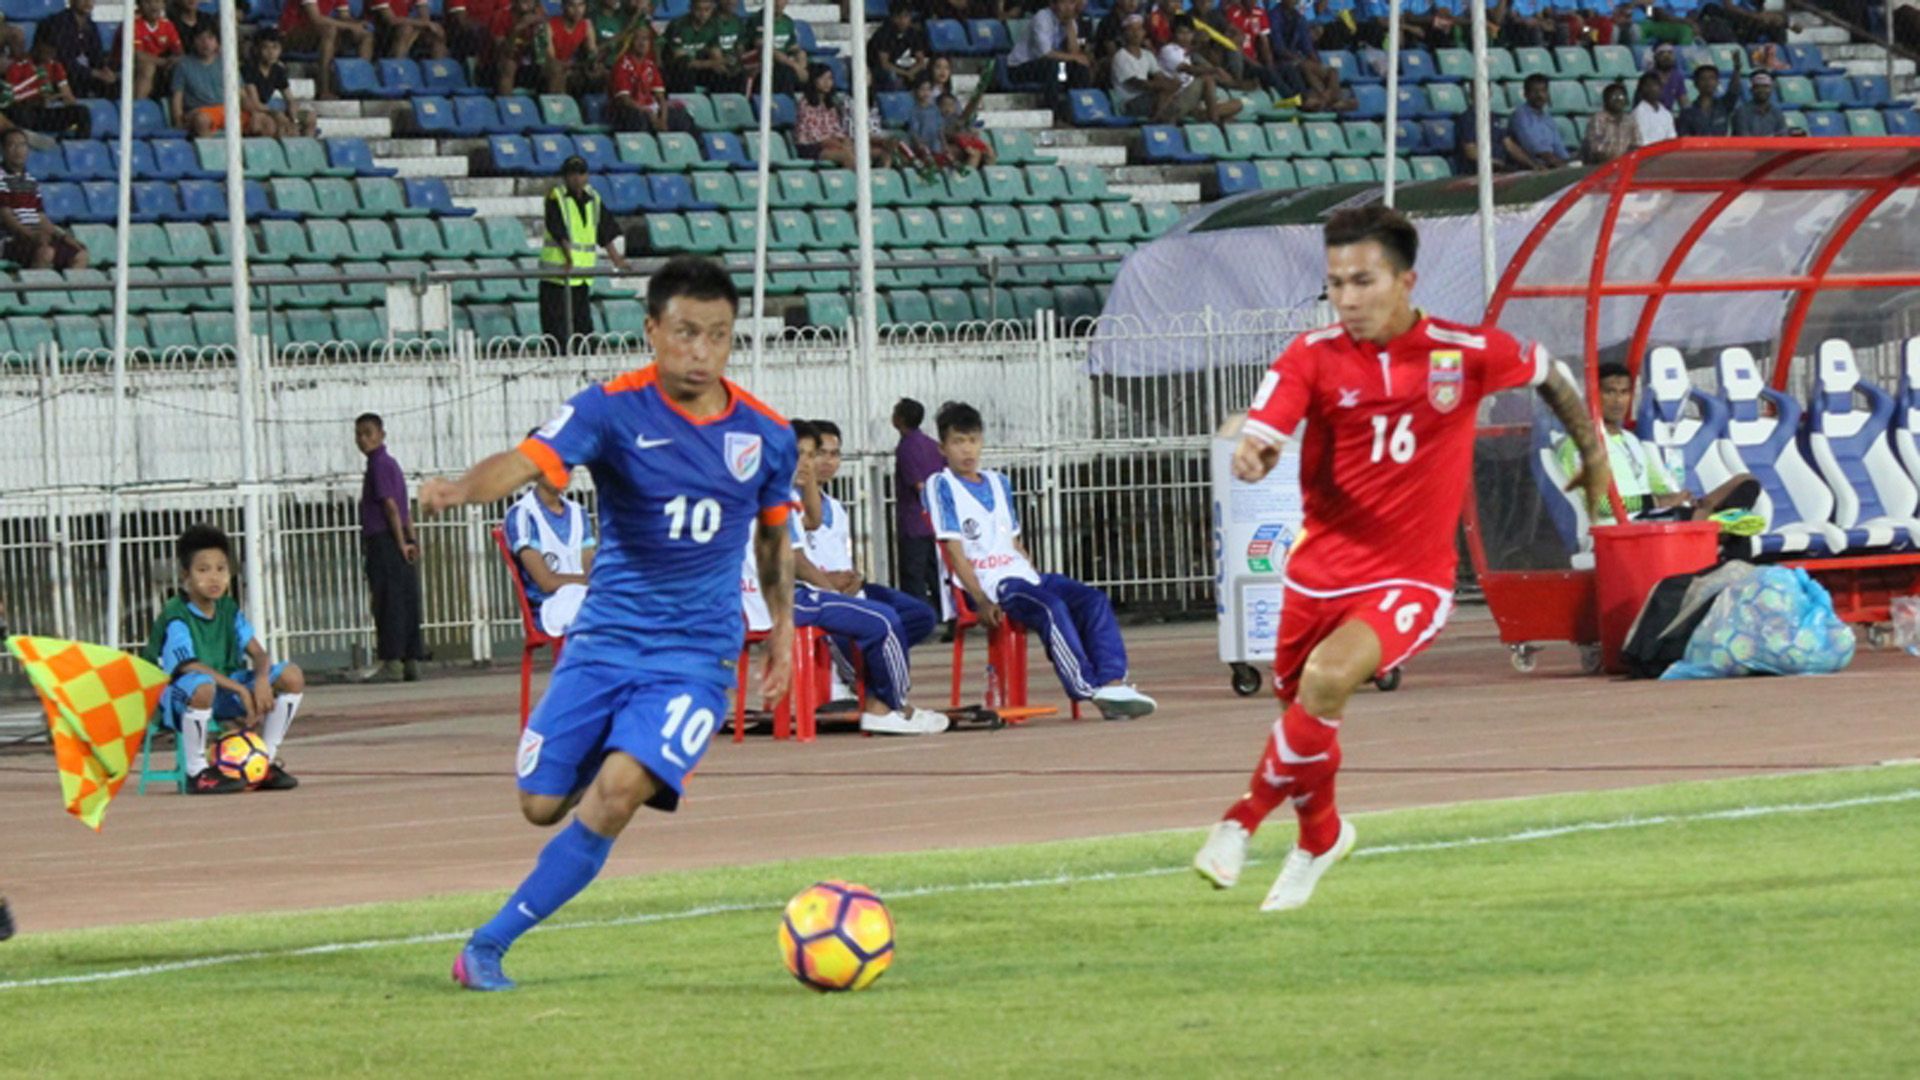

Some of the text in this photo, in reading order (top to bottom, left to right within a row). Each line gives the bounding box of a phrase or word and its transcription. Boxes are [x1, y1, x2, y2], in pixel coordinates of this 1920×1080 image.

[1370, 413, 1416, 463] 16
[664, 494, 722, 543] 10
[1378, 588, 1423, 634] 16
[660, 693, 715, 757] 10
